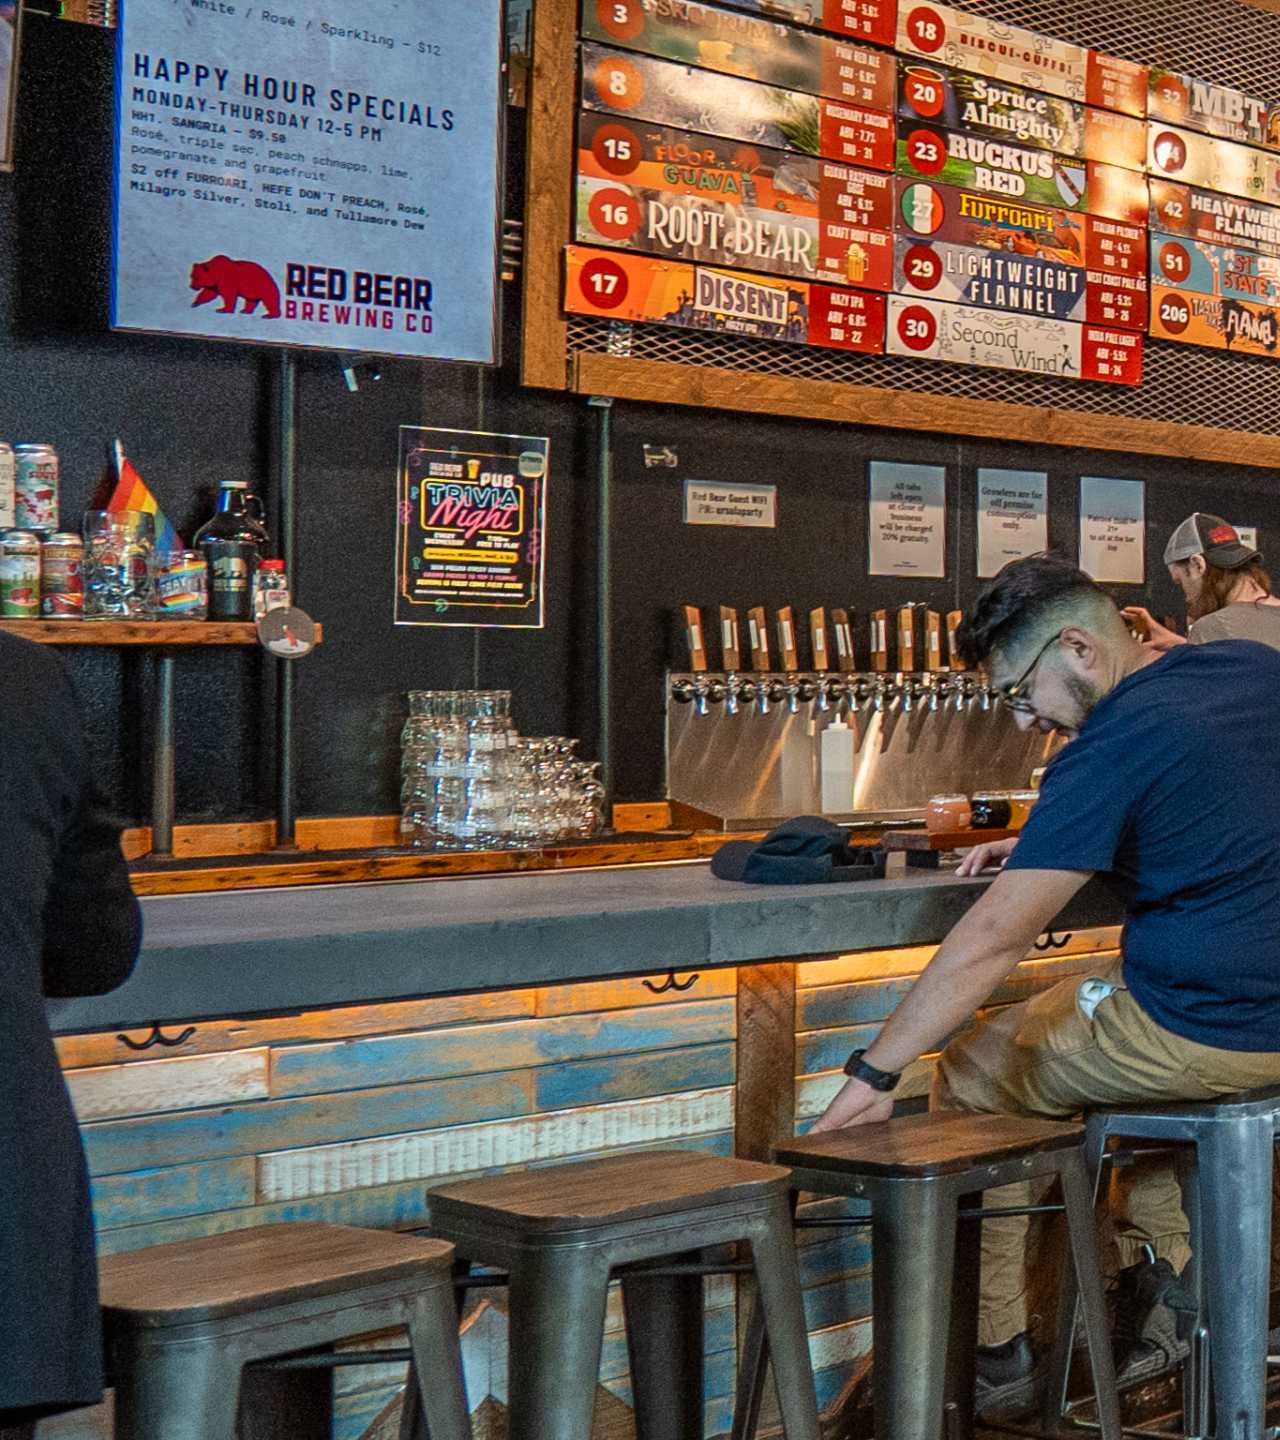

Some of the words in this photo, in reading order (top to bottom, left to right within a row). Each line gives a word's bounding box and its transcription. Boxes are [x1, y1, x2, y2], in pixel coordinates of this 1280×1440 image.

[612, 3, 628, 24] 3
[261, 10, 297, 28] Rosé
[320, 22, 395, 50] Sparkling
[416, 41, 442, 57] $12
[914, 20, 937, 41] 18
[133, 53, 229, 92] HAPPY
[244, 73, 316, 108] HOUR
[330, 89, 455, 132] SPECIALS
[609, 70, 627, 96] 8
[912, 83, 936, 104] 20
[971, 78, 1048, 115] Spruce
[1161, 88, 1181, 105] 32
[1191, 82, 1266, 130] MBT
[132, 86, 310, 130] MONDAY-THURSDAY
[317, 118, 353, 138] 12-5
[360, 125, 382, 142] PM
[171, 116, 227, 135] SANGRIA
[961, 102, 1064, 148] Almighty
[179, 133, 225, 151] triple
[268, 148, 305, 163] peach
[603, 138, 631, 161] 15
[655, 143, 717, 166] FLOOR
[914, 141, 938, 162] 23
[947, 133, 1055, 180] RUCKUS
[224, 158, 246, 170] and
[131, 163, 147, 176] $2
[154, 167, 179, 180] off
[262, 183, 293, 197] HEFE
[342, 194, 391, 212] PREACH,
[663, 163, 738, 194] GUAVA
[974, 166, 1026, 198] RED
[130, 180, 186, 198] Milagro
[193, 188, 245, 208] Silver,
[254, 197, 297, 215] Stoli,
[305, 205, 328, 217] and
[335, 209, 398, 227] Tullamore
[403, 219, 425, 231] Dew
[600, 203, 629, 226] 16
[911, 200, 934, 218] 27
[958, 193, 1055, 233] Furroari
[1163, 200, 1183, 218] 42
[647, 200, 725, 250] ROOT
[735, 216, 815, 273] BEAR
[910, 258, 934, 279] 29
[946, 250, 1080, 294] LIGHTWEIGHT
[1164, 253, 1184, 272] 51
[285, 262, 347, 301] RED
[353, 271, 433, 312] BEAR
[589, 272, 619, 295] 17
[1222, 271, 1270, 297] STATE
[699, 273, 786, 321] DISSENT
[970, 280, 1056, 315] FLANNEL
[285, 299, 394, 330] BREWING
[405, 313, 433, 334] CO
[1160, 304, 1188, 324] 206
[904, 318, 929, 338] 30
[951, 321, 1019, 349] Second
[1010, 348, 1058, 372] Wind
[480, 472, 514, 489] PUB
[981, 486, 1017, 499] Growlers
[426, 483, 518, 511] TRIVIA
[691, 491, 707, 502] Red
[709, 492, 727, 504] Bear
[729, 494, 749, 505] Guest
[428, 495, 519, 539] Night
